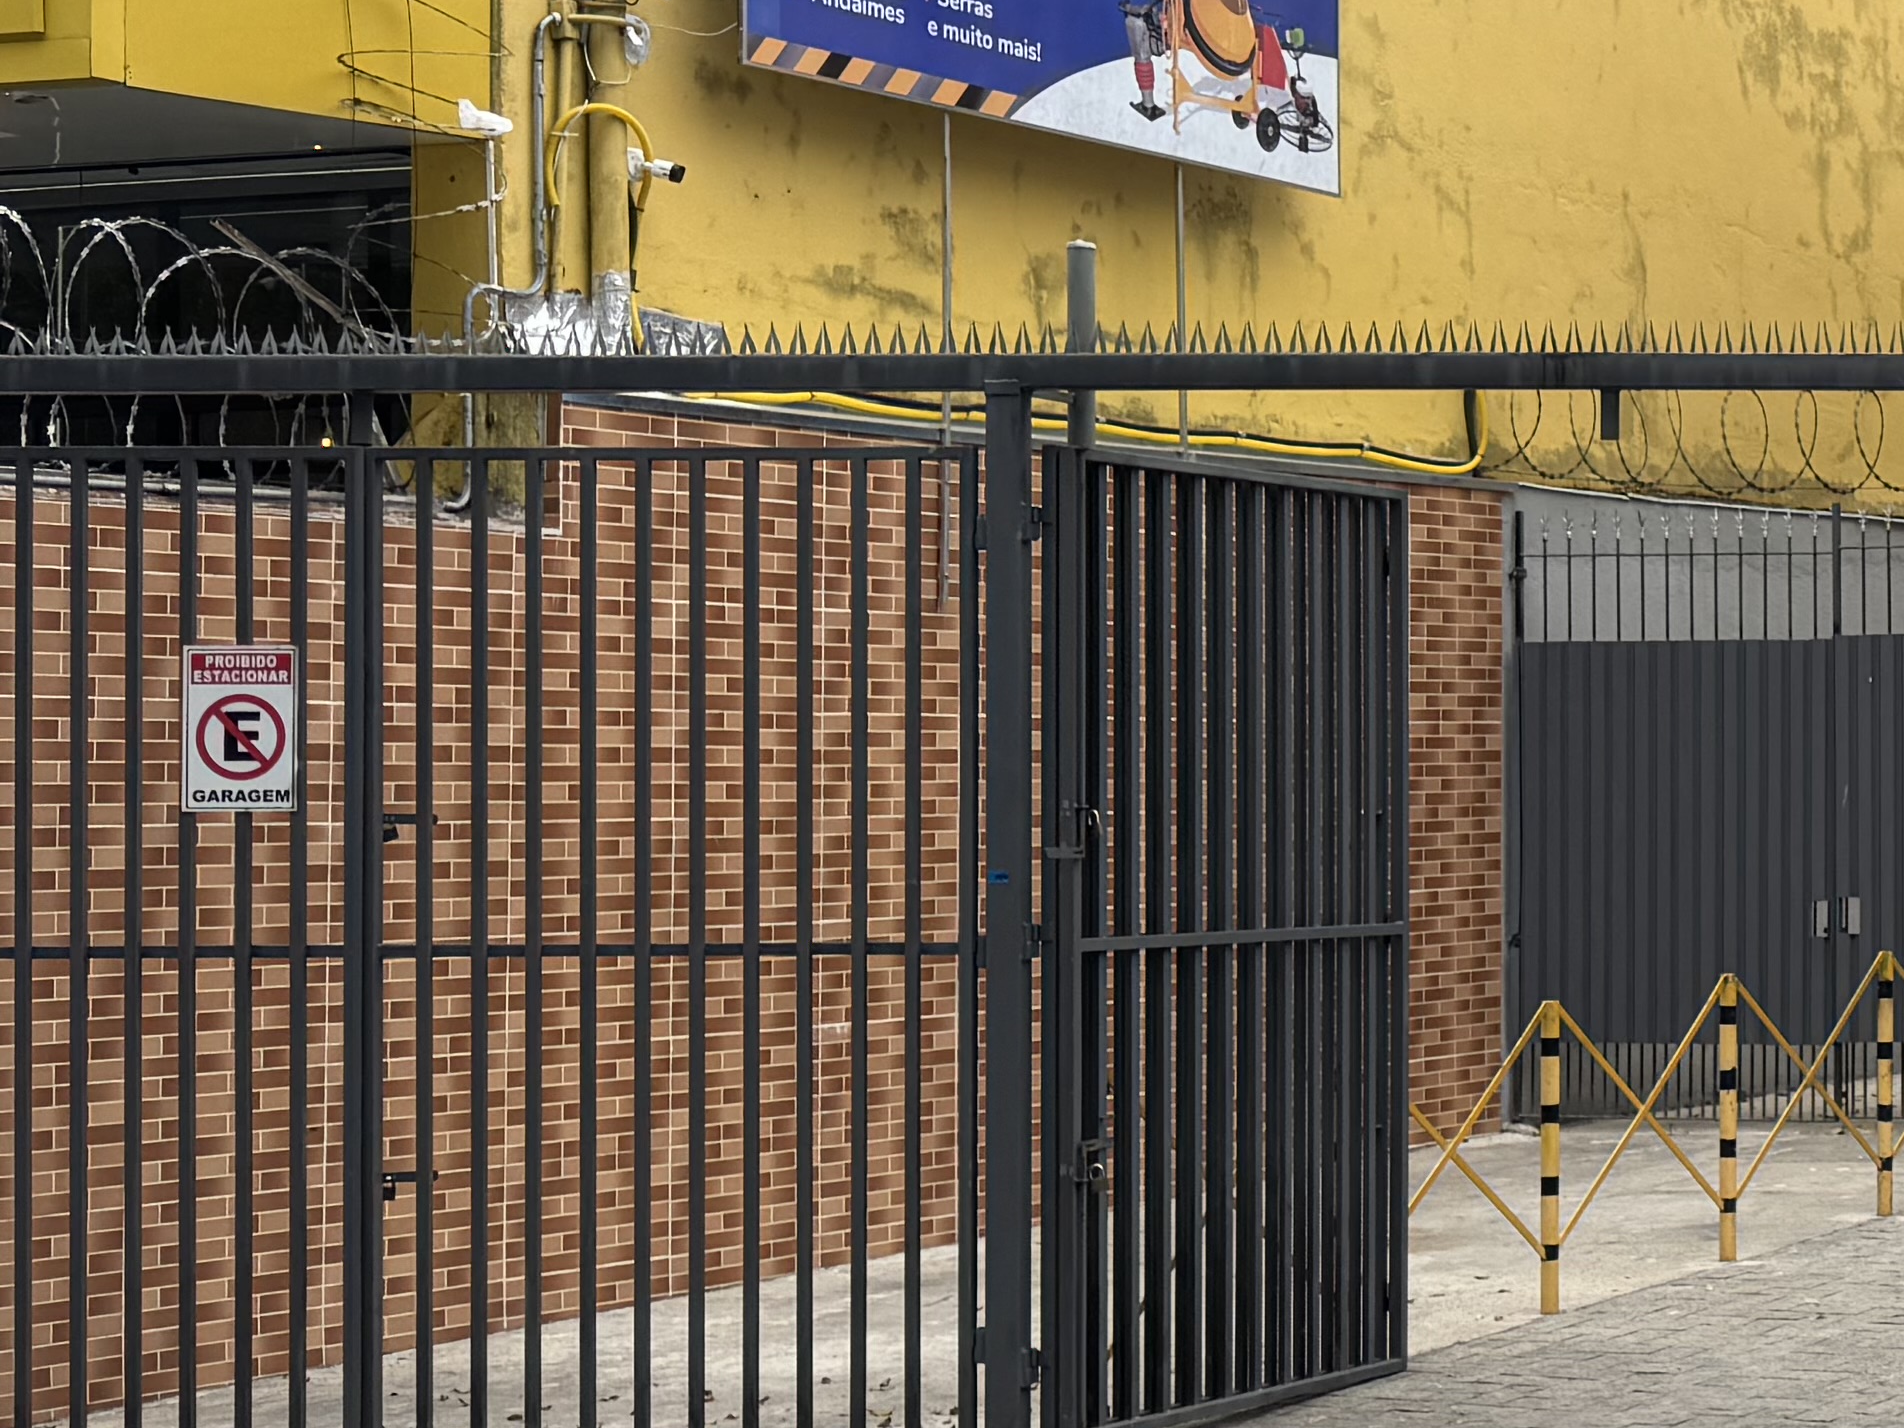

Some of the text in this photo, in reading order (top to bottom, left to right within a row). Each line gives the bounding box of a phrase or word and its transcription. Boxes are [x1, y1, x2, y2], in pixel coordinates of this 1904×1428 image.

[927, 20, 1042, 62] e muito mais!
[205, 655, 277, 668] PROIBIDO
[193, 670, 289, 683] ESTACIONAR
[192, 789, 290, 803] GARAGEM
